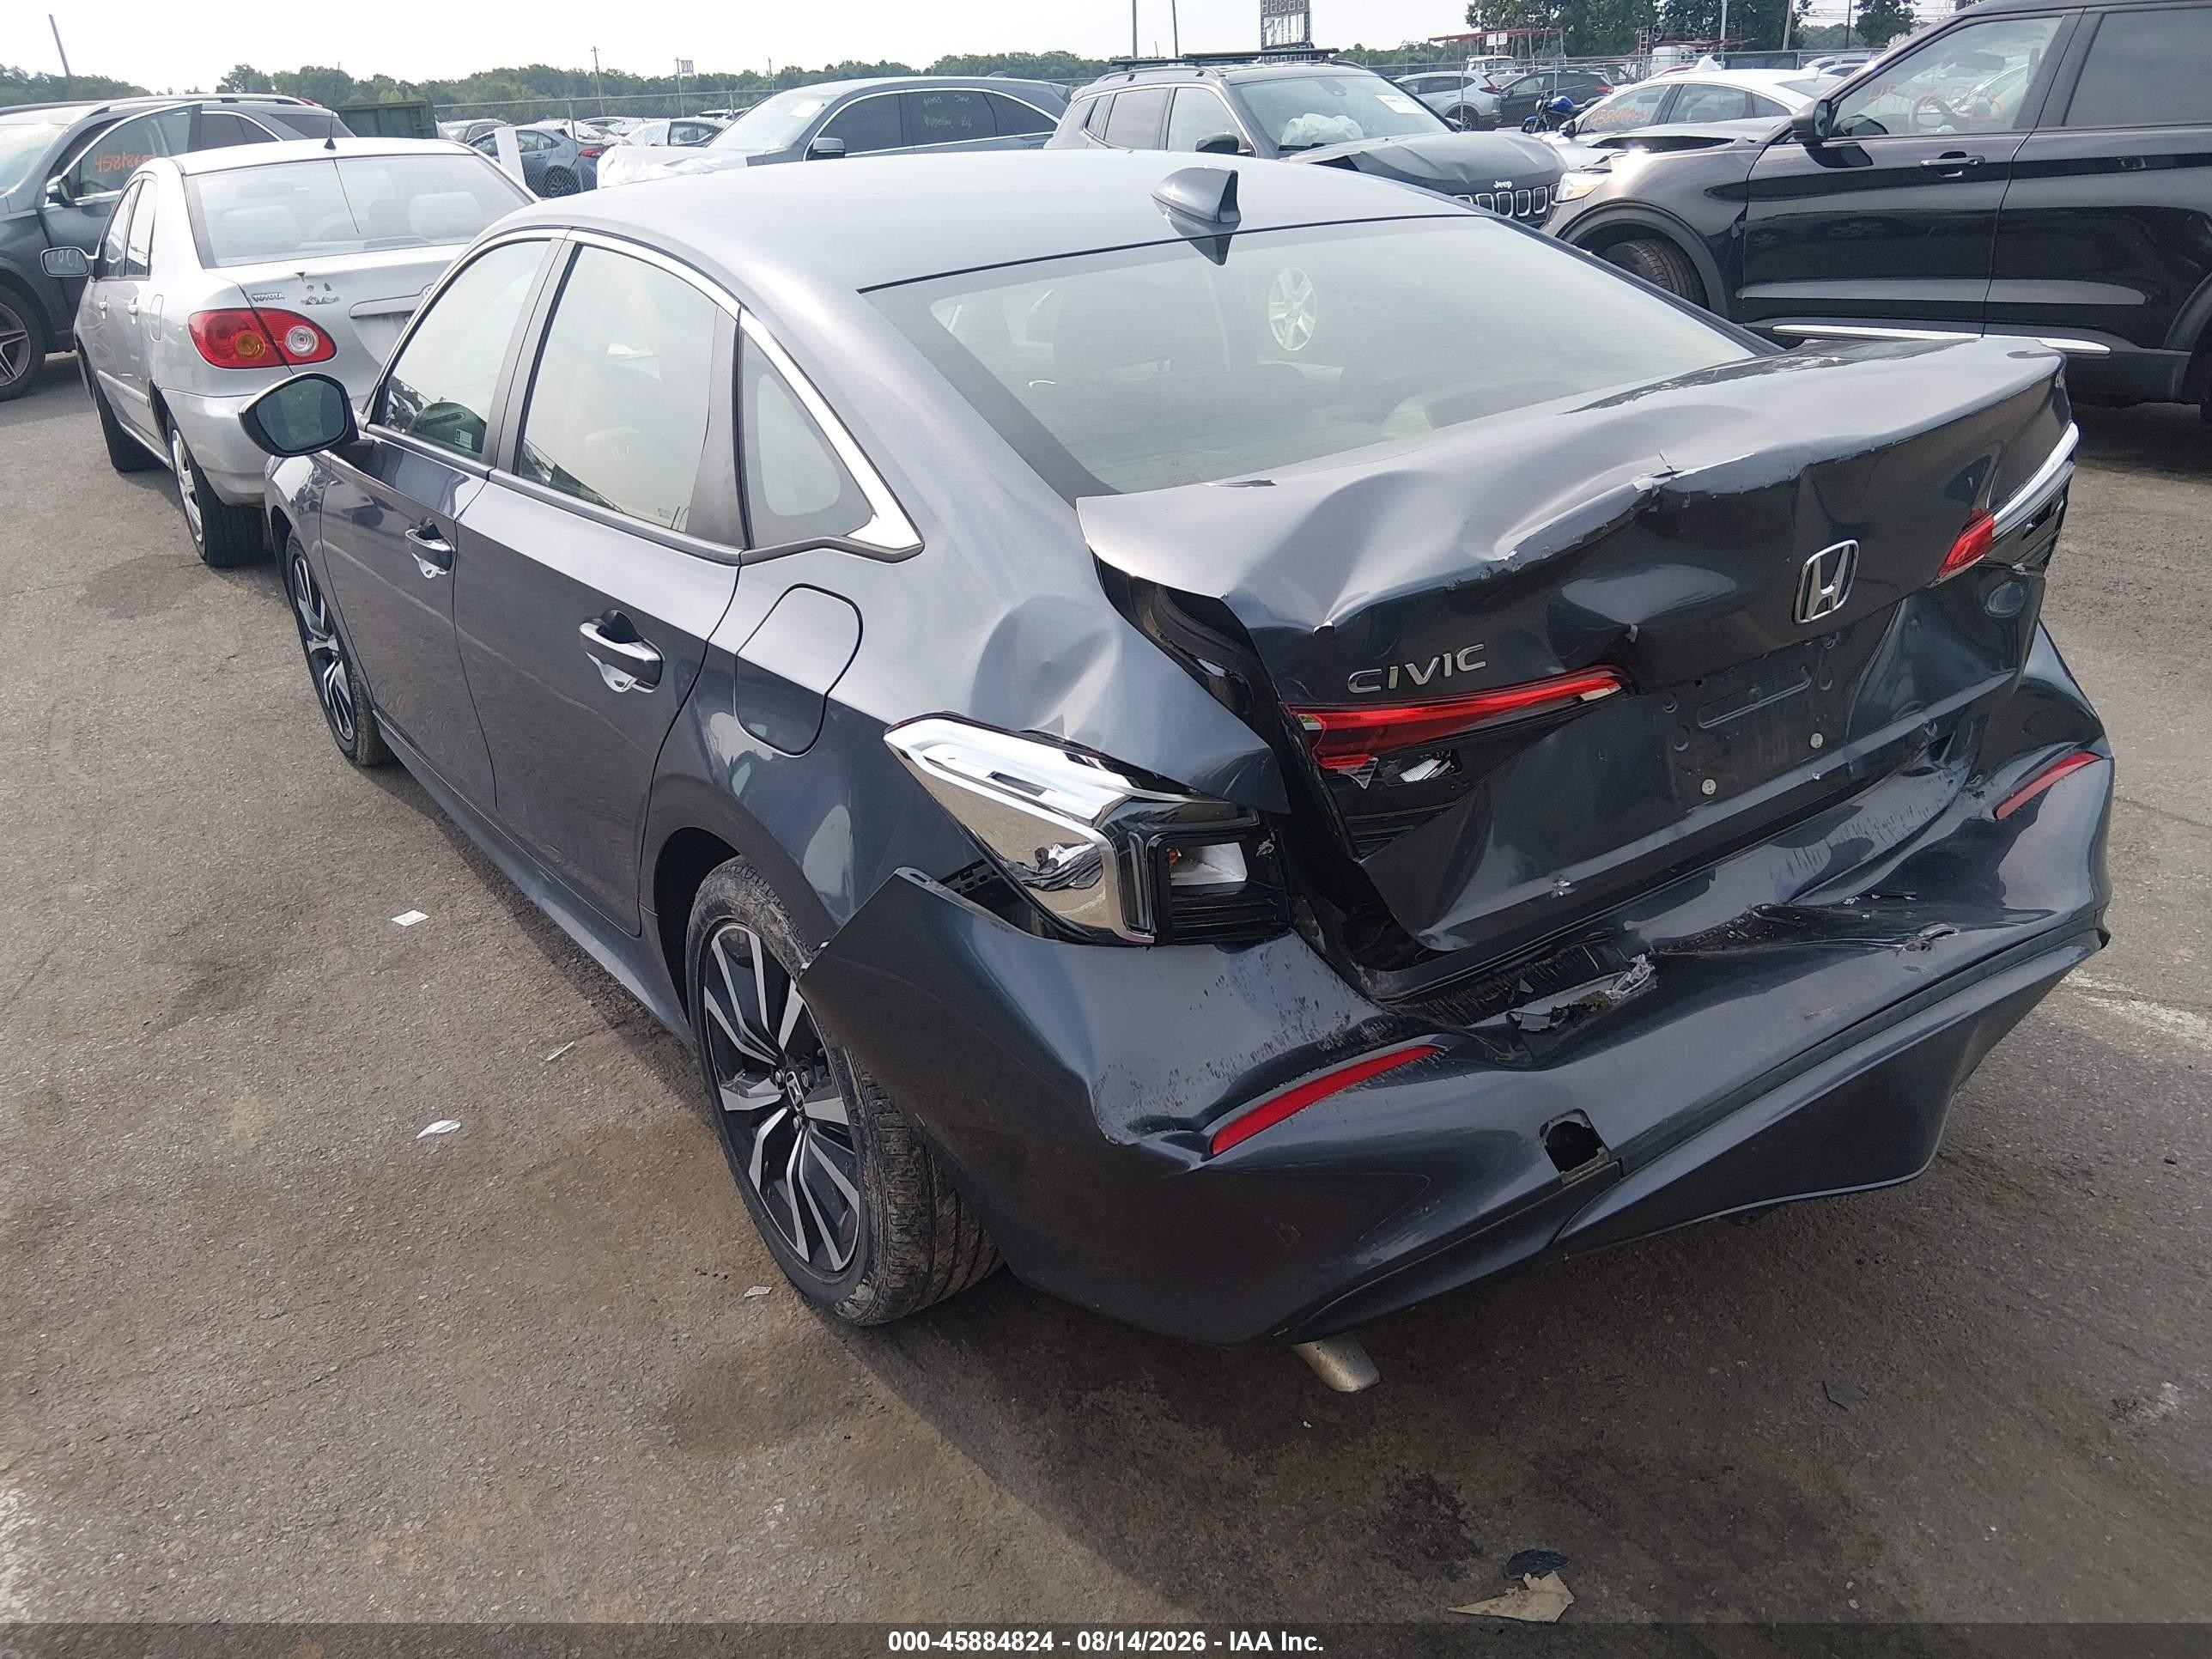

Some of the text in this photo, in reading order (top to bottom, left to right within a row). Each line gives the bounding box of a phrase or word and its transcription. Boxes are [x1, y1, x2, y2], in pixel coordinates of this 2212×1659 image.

[1493, 180, 1512, 189] Jeep
[252, 292, 285, 302] TOYOTA
[1347, 644, 1486, 694] CIVIC
